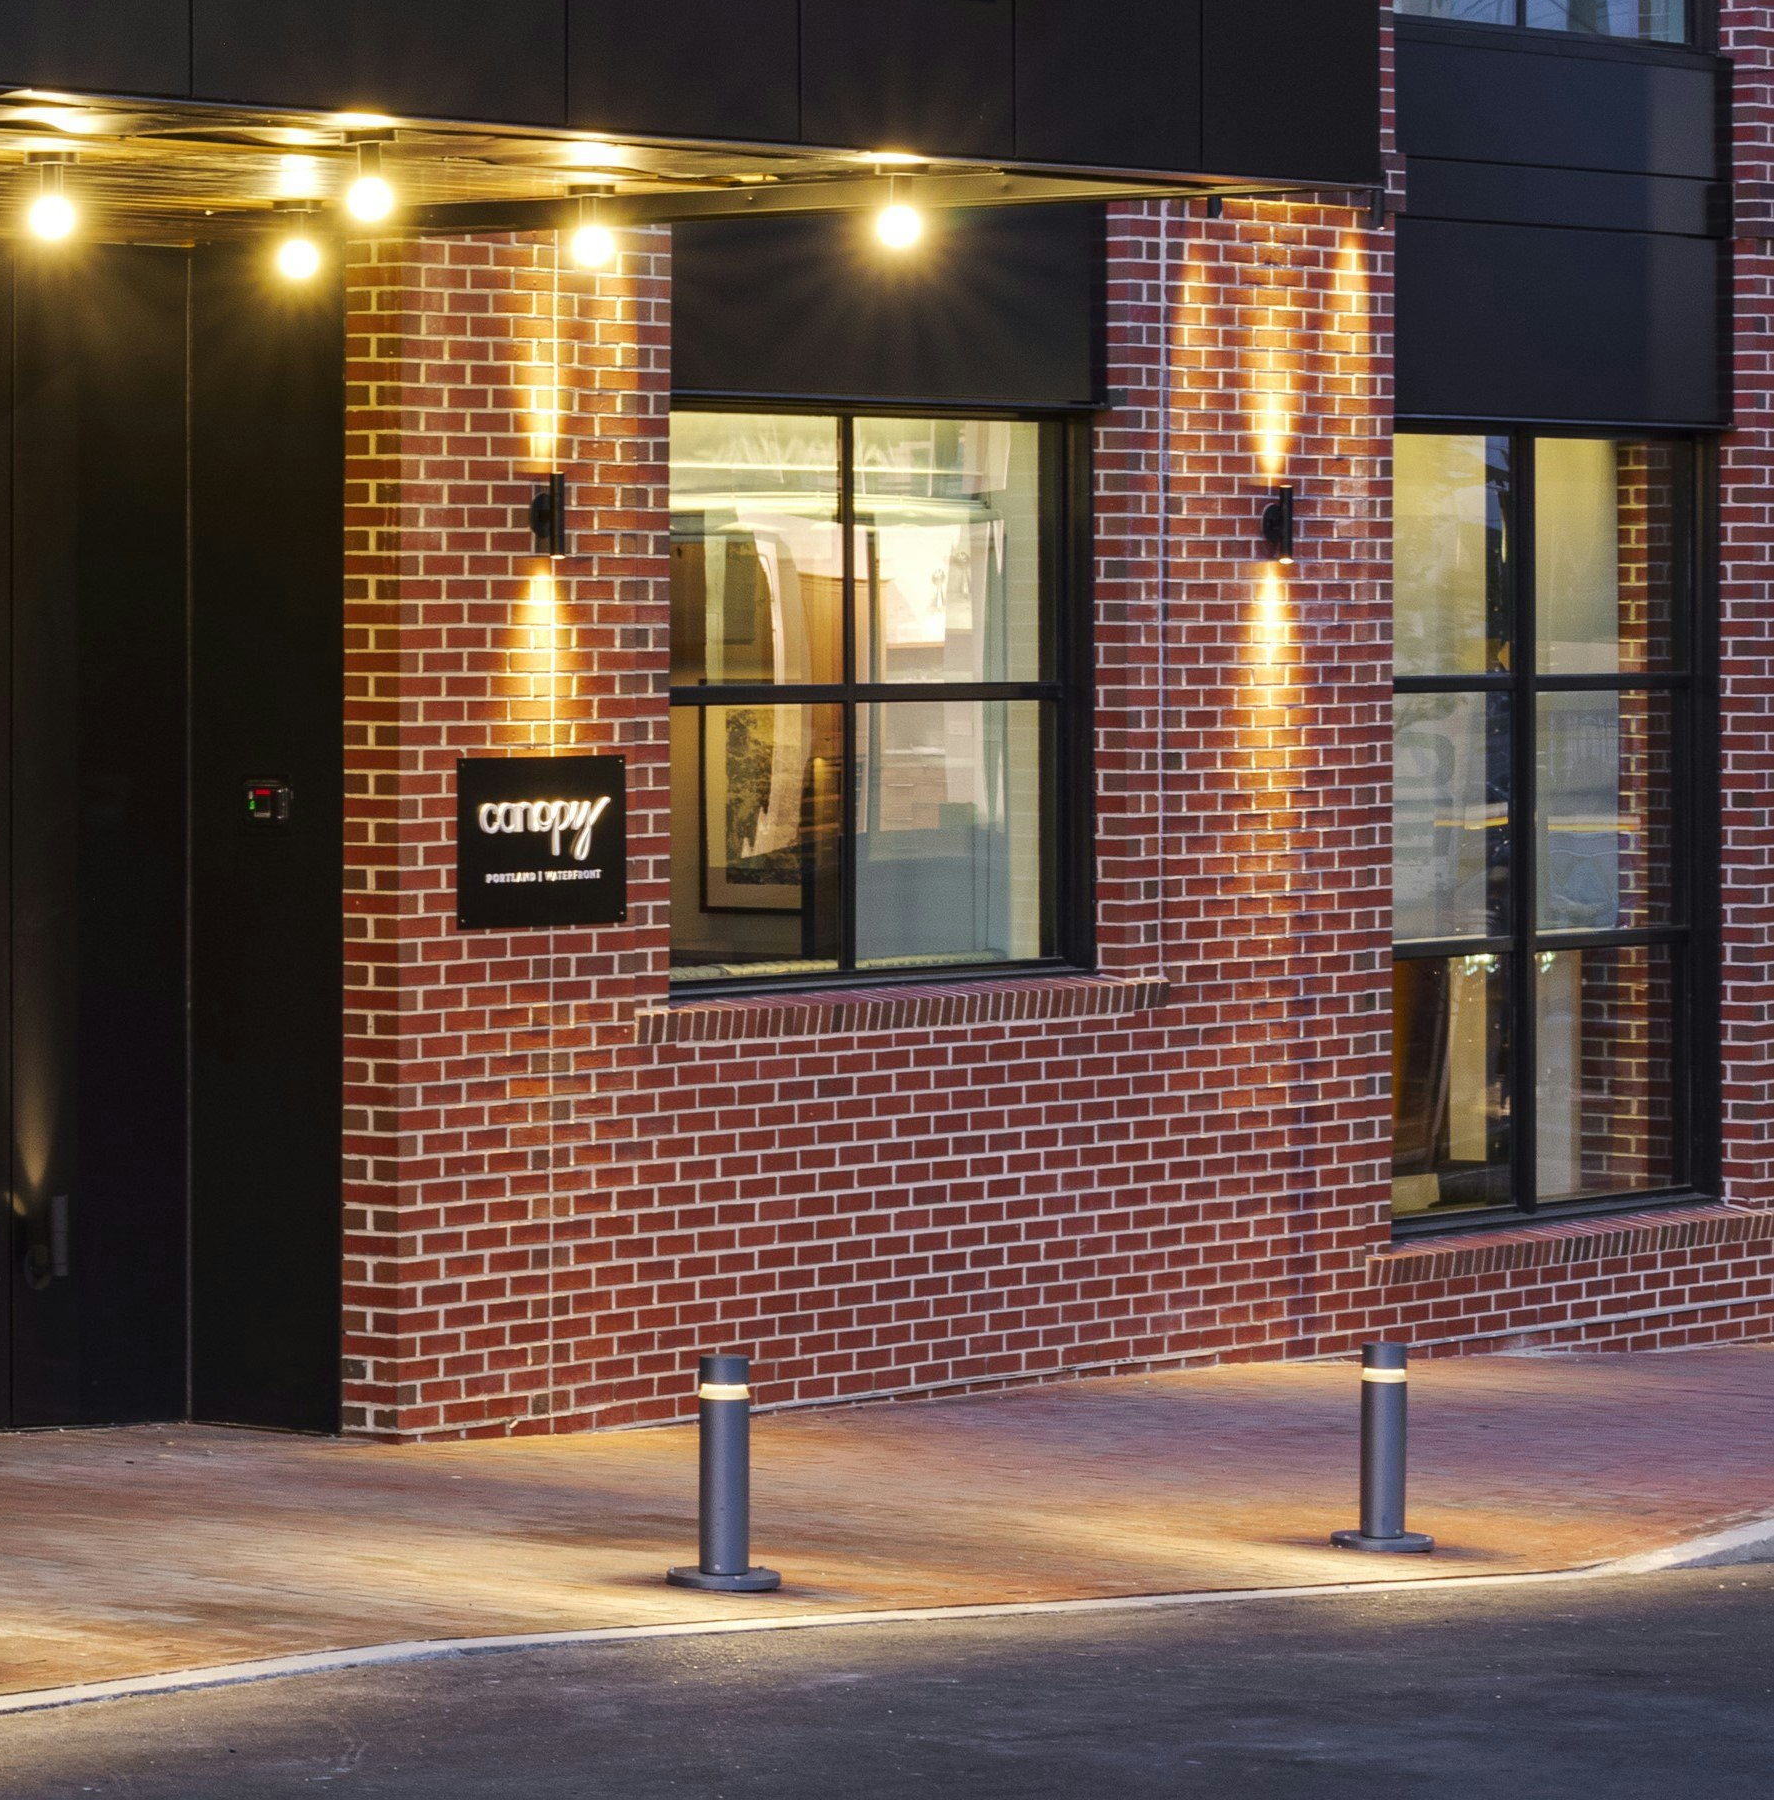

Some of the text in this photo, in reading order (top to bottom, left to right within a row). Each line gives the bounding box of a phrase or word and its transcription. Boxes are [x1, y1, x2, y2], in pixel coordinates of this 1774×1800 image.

[479, 796, 612, 861] canopy
[485, 872, 536, 883] PORTLAND
[544, 869, 602, 881] WATERFRONT
